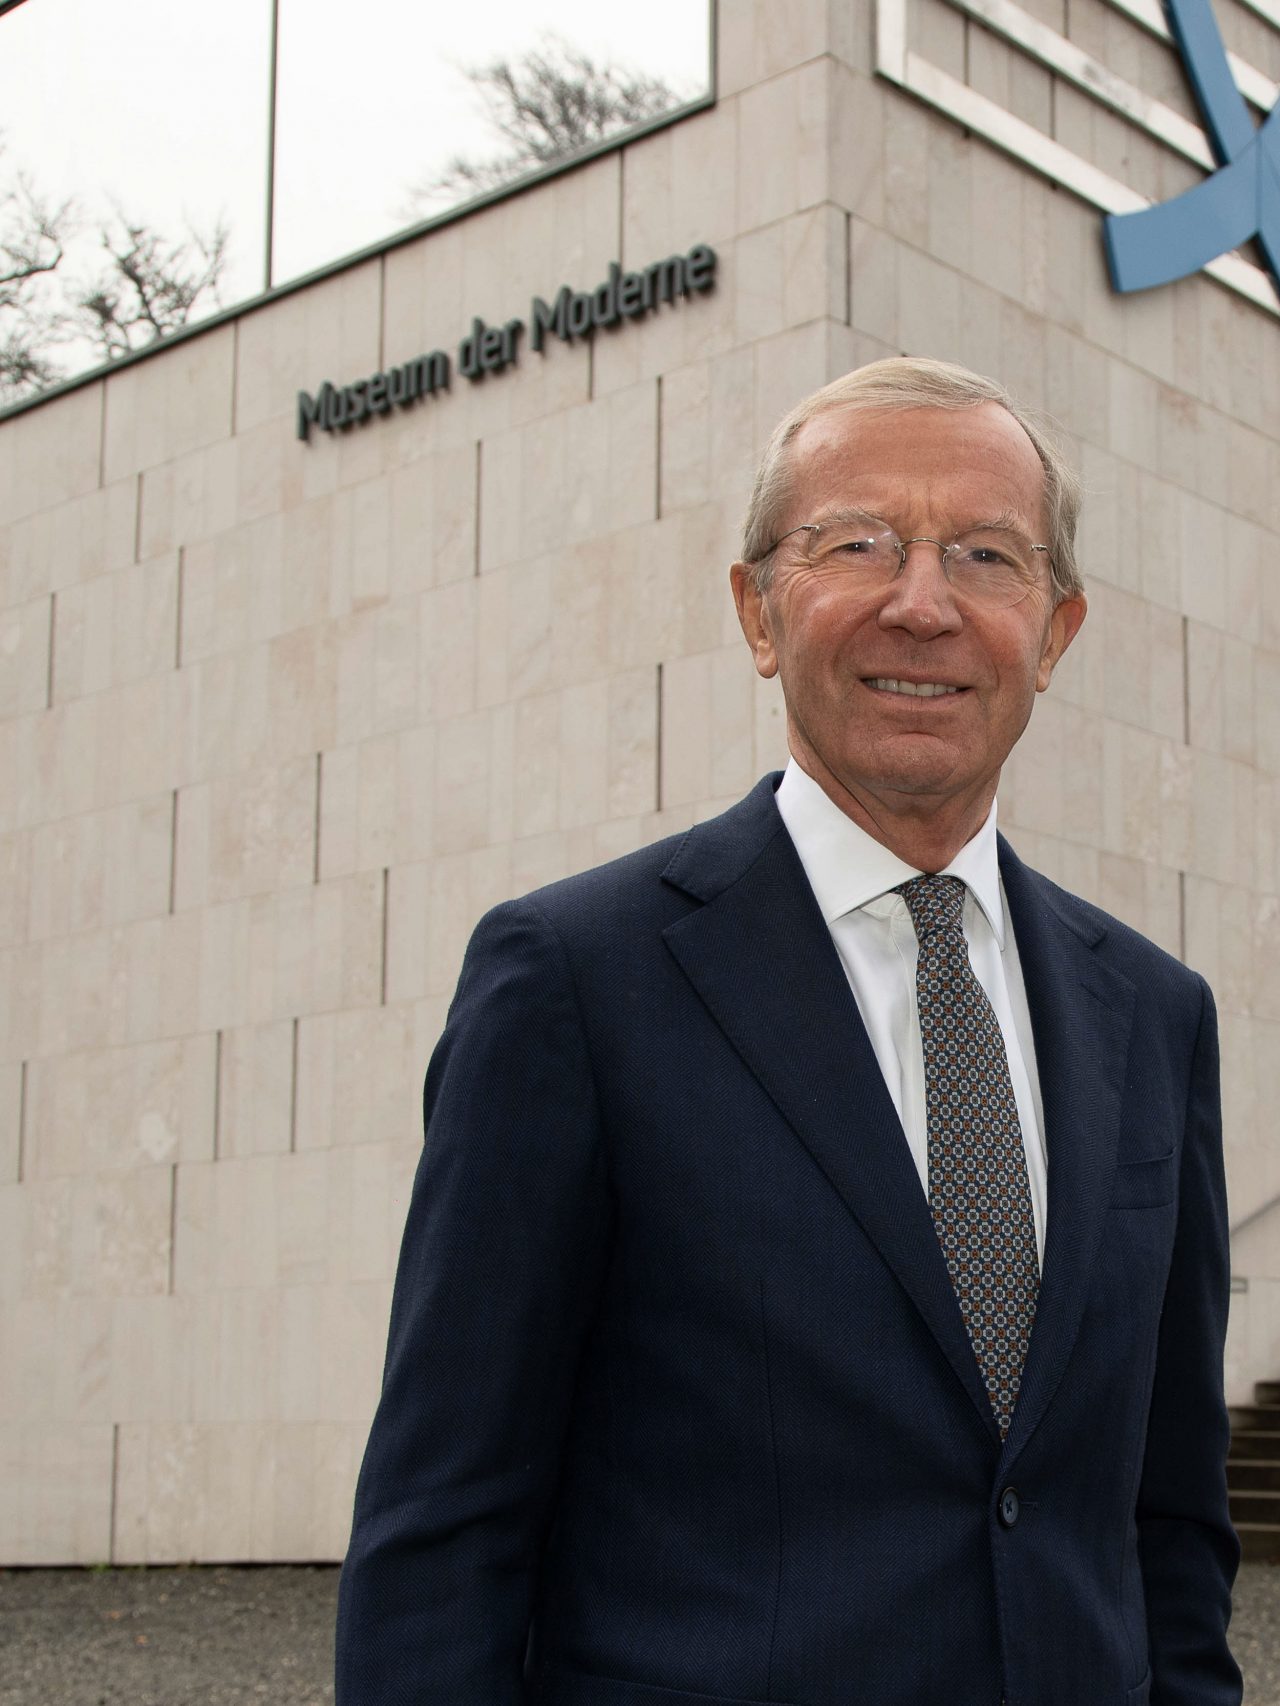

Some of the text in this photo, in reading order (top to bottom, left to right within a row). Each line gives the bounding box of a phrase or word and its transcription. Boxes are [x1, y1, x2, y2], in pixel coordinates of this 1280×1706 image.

[296, 243, 718, 441] Museum der Moderne
